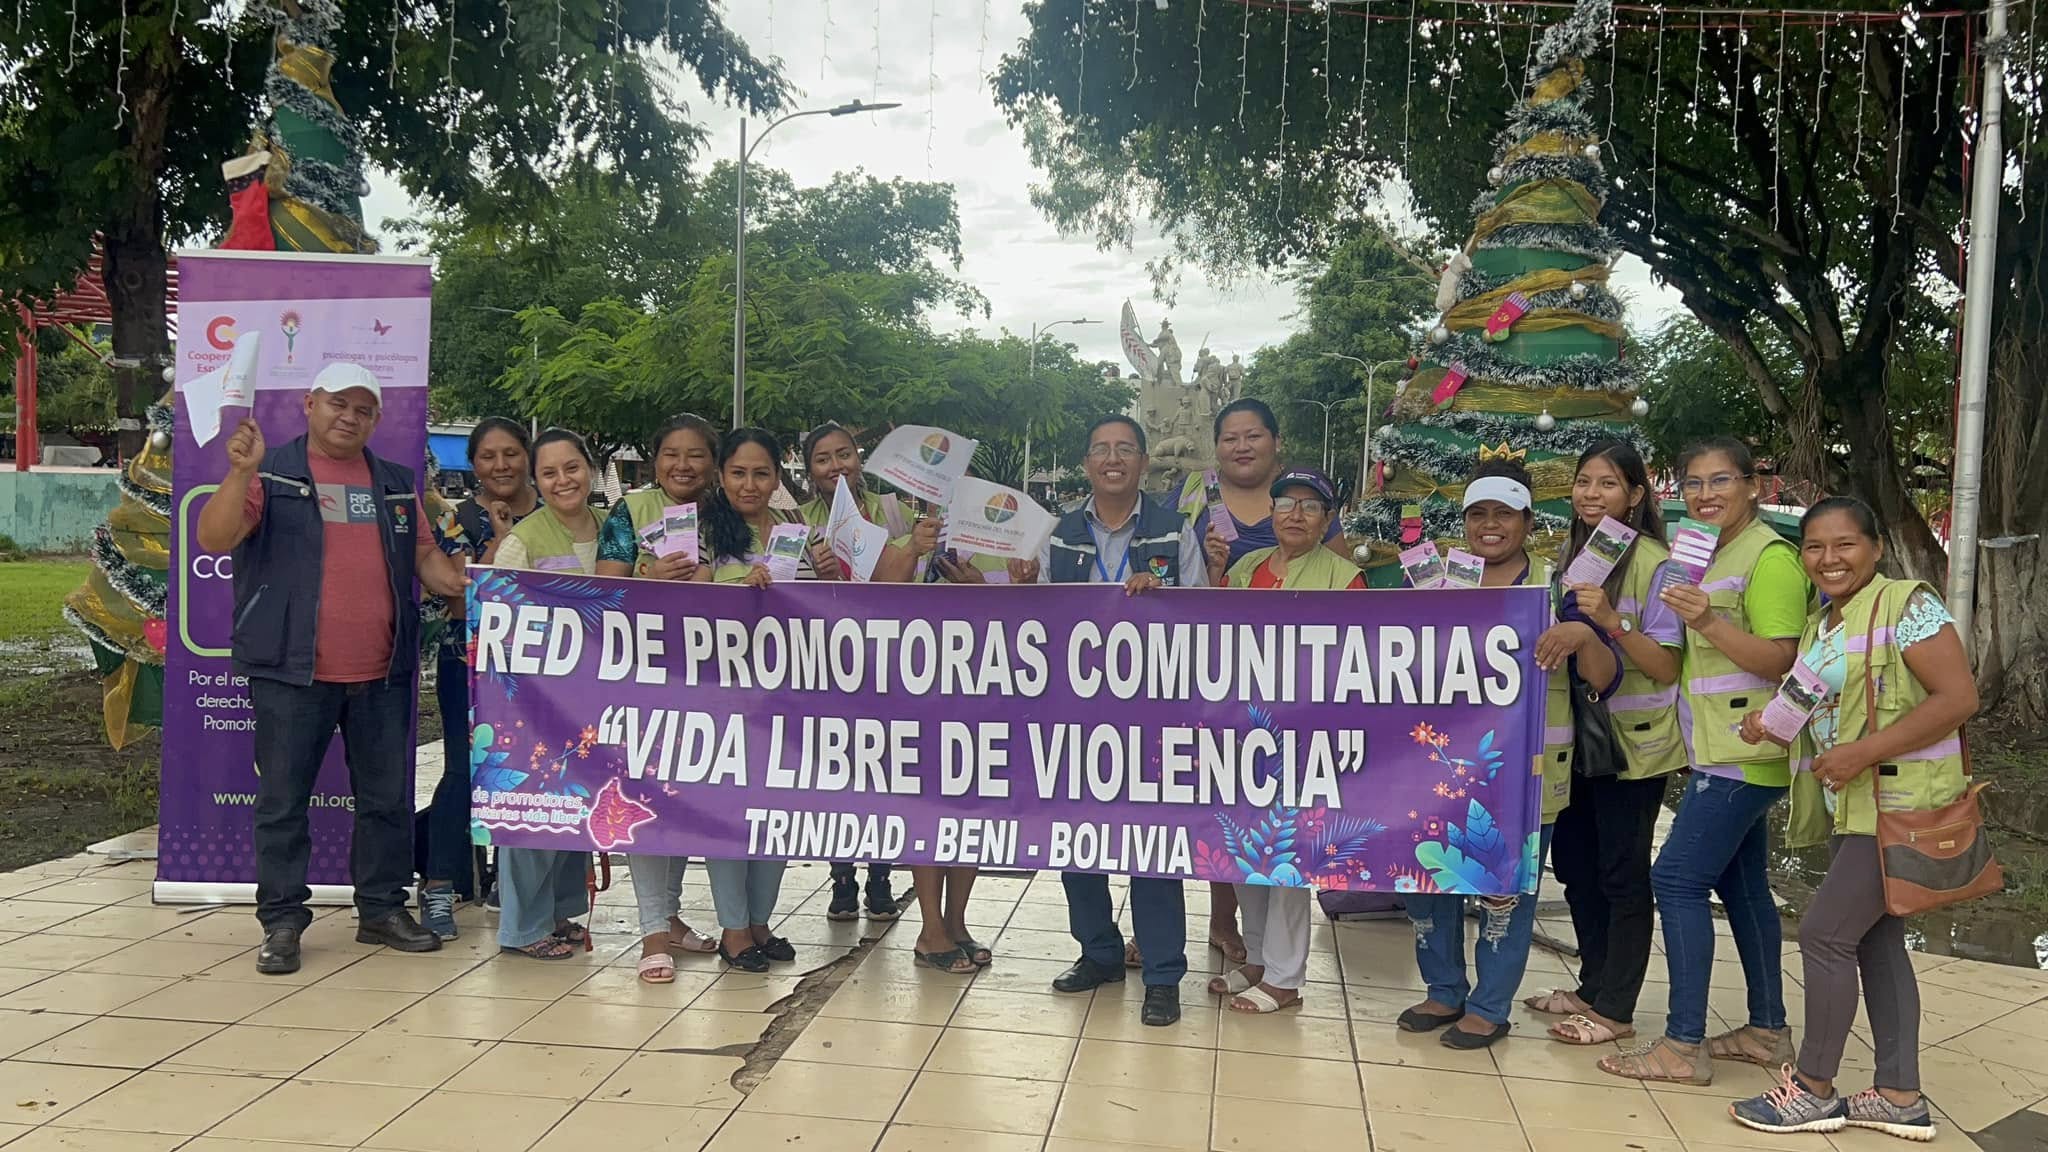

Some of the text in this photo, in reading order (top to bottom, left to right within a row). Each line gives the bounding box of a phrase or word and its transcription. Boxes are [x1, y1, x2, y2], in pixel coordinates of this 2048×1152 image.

[349, 493, 372, 504] RIP
[475, 601, 1521, 706] RED DE PROMOTORAS COMUNITARIAS
[189, 670, 212, 685] Por
[215, 672, 228, 686] el
[598, 705, 1366, 809] “VIDA LIBRE DE VIOLENCIA”
[491, 791, 583, 808] promotoras
[521, 808, 549, 823] vida
[550, 809, 581, 825] libre
[745, 808, 906, 860] TRINIDAD
[934, 817, 1019, 866] BENI
[1049, 821, 1194, 875] BOLIVIA
